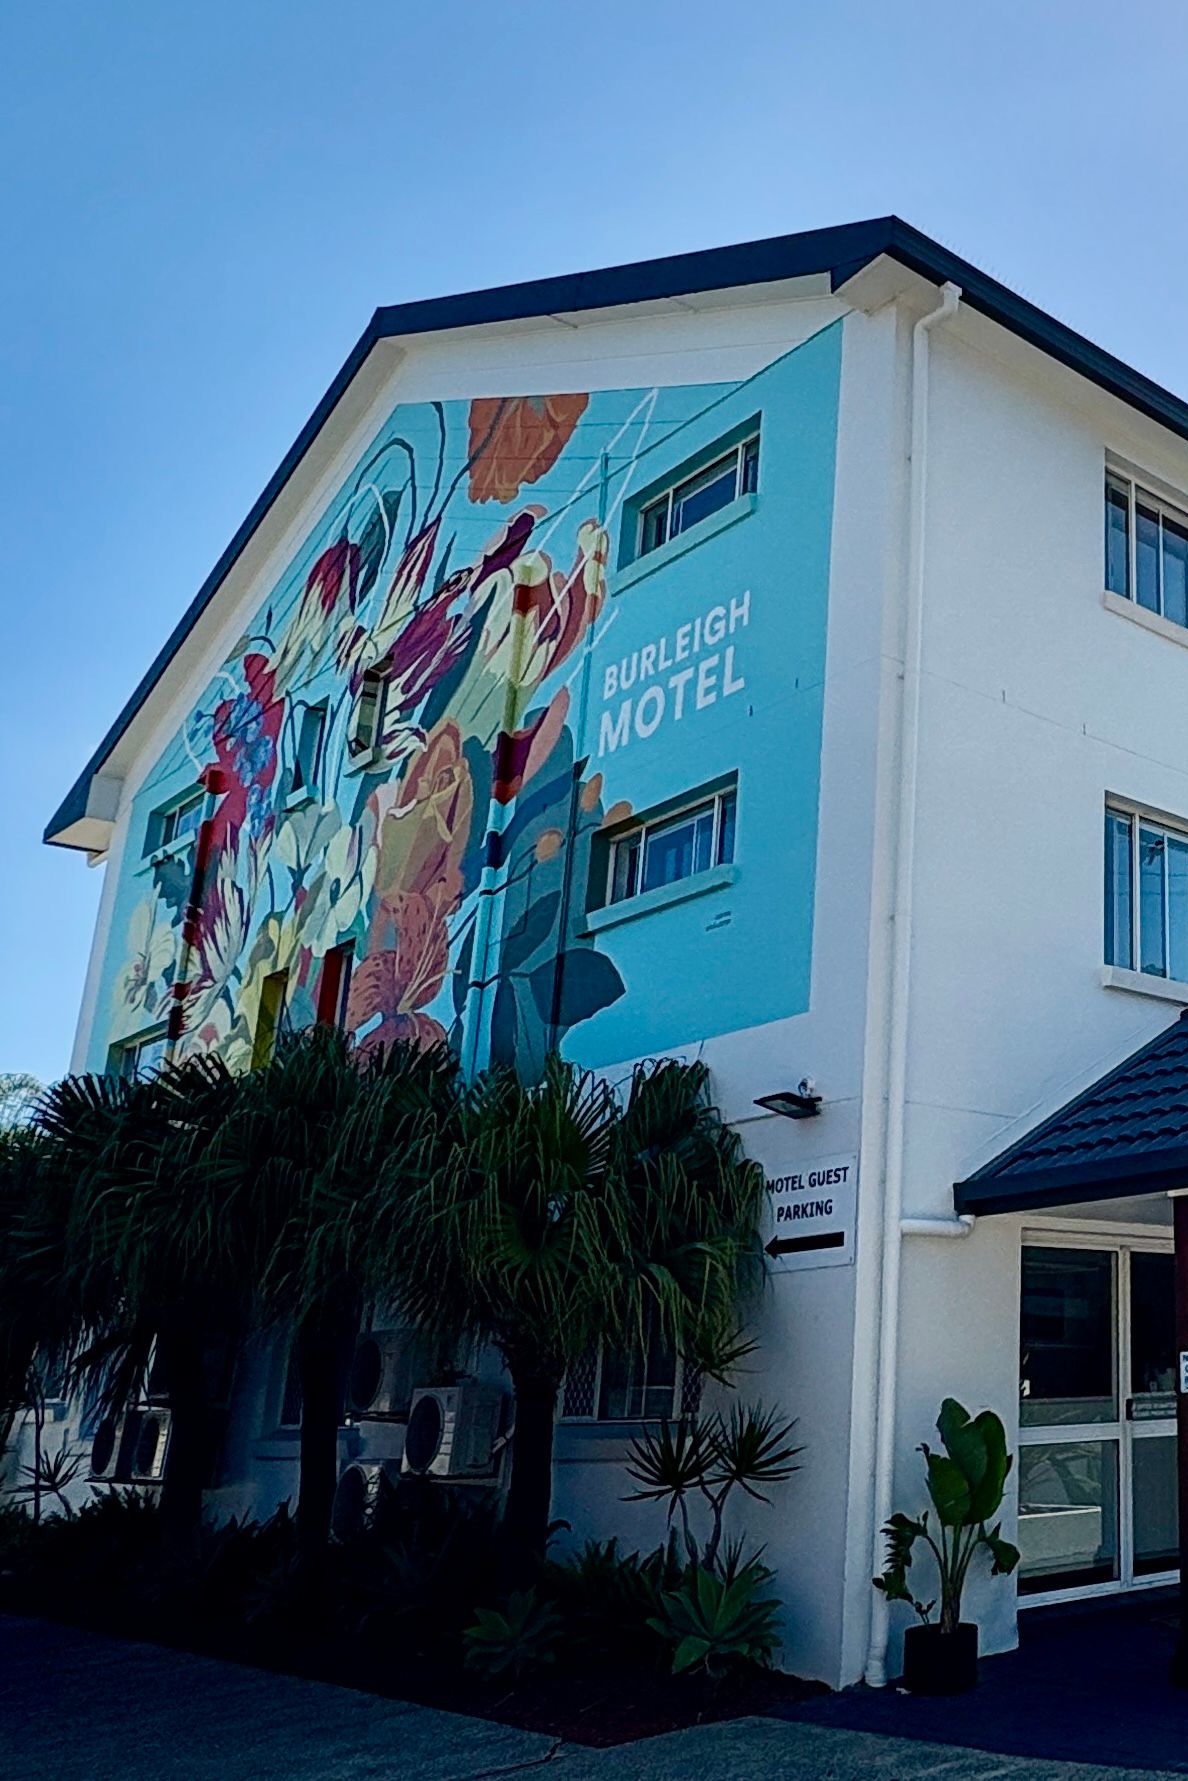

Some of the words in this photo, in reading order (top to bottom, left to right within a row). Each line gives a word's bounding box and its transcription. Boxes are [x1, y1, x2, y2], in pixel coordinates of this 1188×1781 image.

[603, 590, 751, 701] BURLEIGH
[597, 645, 746, 758] MOTEL
[766, 1174, 805, 1195] MOTEL
[808, 1166, 849, 1188] GUEST
[776, 1199, 833, 1222] PARKING
